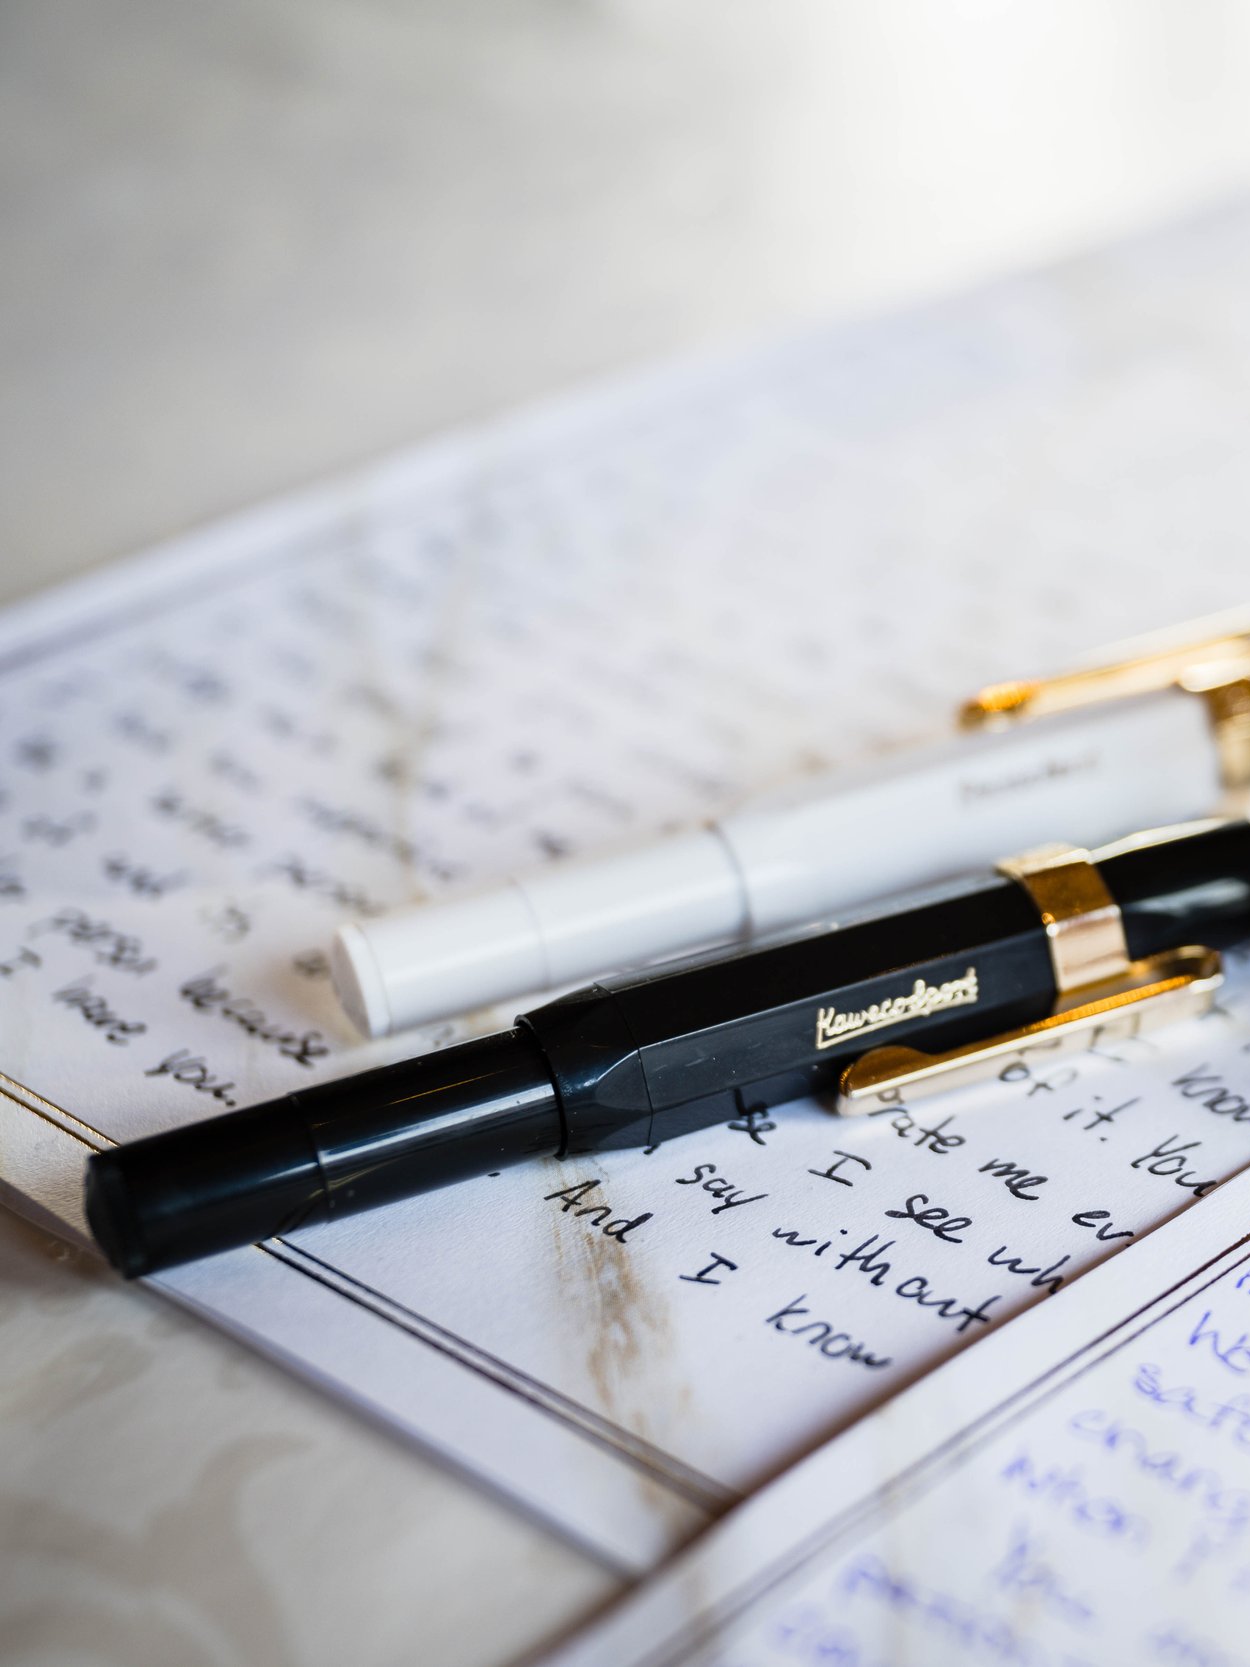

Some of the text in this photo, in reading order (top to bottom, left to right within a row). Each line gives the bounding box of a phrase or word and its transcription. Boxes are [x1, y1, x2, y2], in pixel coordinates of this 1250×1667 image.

[543, 1178, 893, 1370] And I know
[675, 1162, 1002, 1332] say without
[807, 1149, 872, 1187] I
[884, 1193, 971, 1244] see
[987, 1244, 1071, 1295] wh
[978, 1157, 1049, 1200] me
[1071, 1209, 1134, 1247] ev
